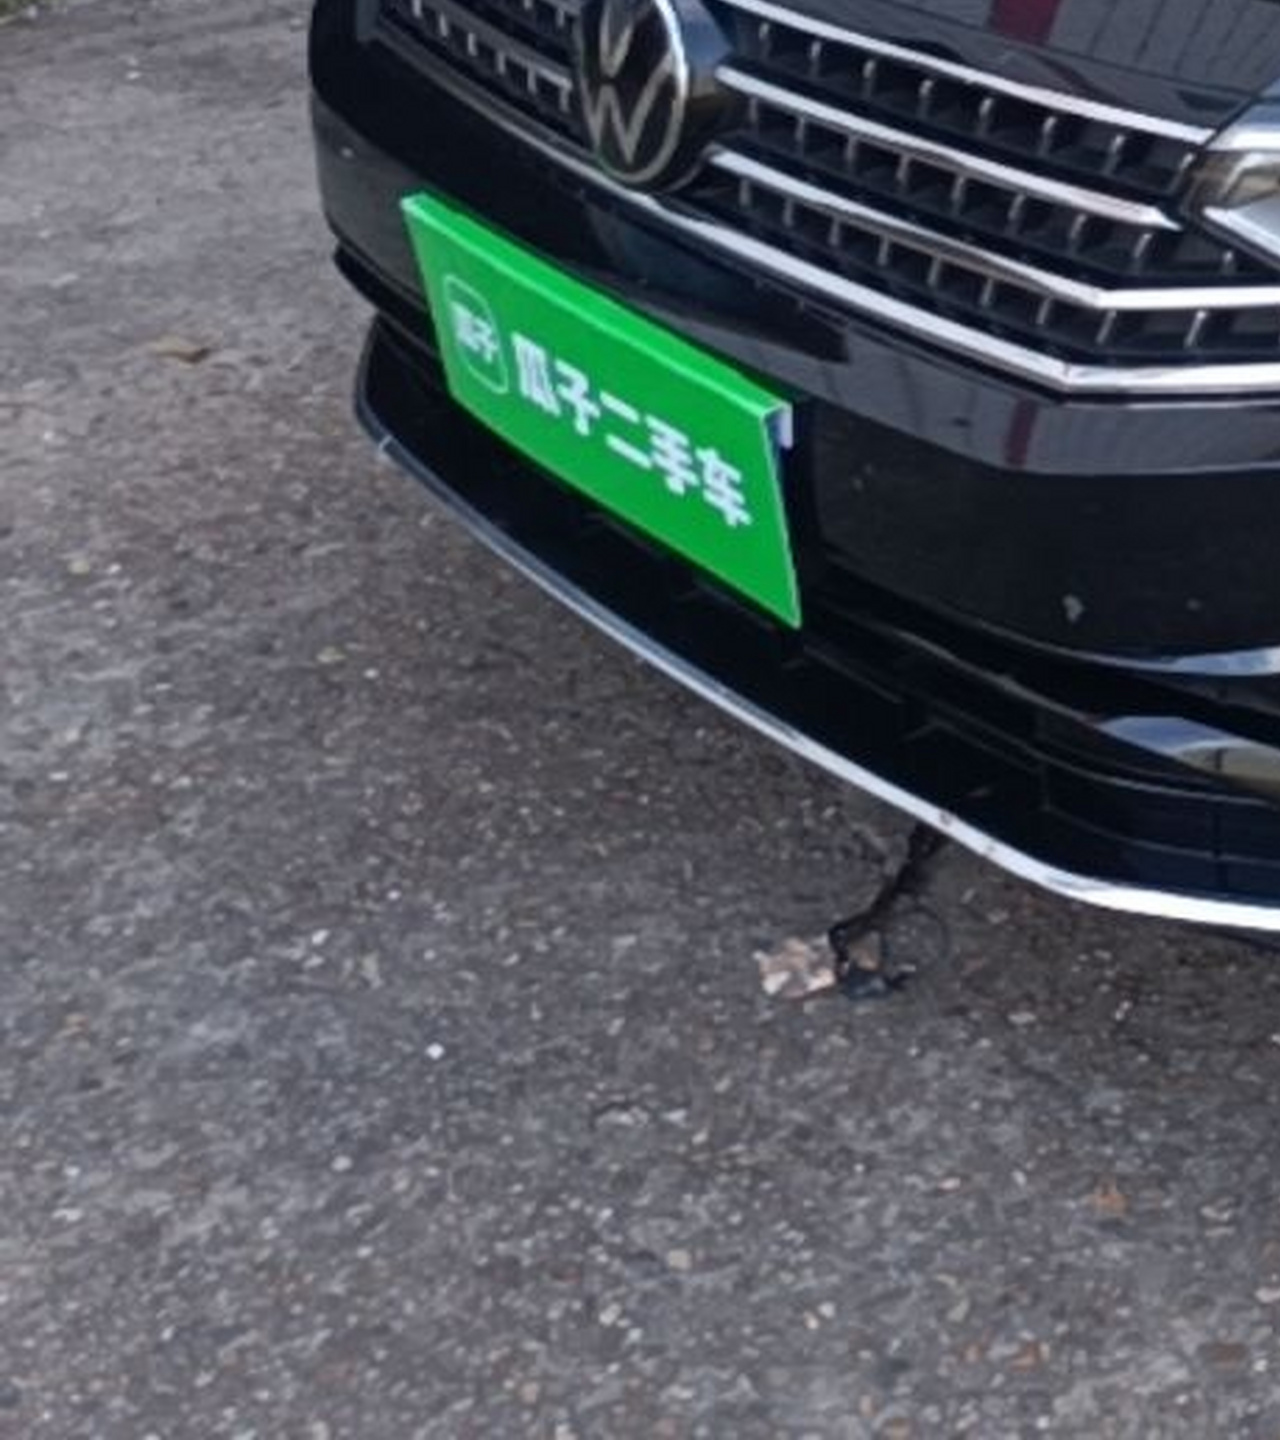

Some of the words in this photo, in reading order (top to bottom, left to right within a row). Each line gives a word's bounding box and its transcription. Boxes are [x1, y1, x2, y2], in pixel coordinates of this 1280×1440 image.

[511, 330, 752, 528] 瓜子二手车
